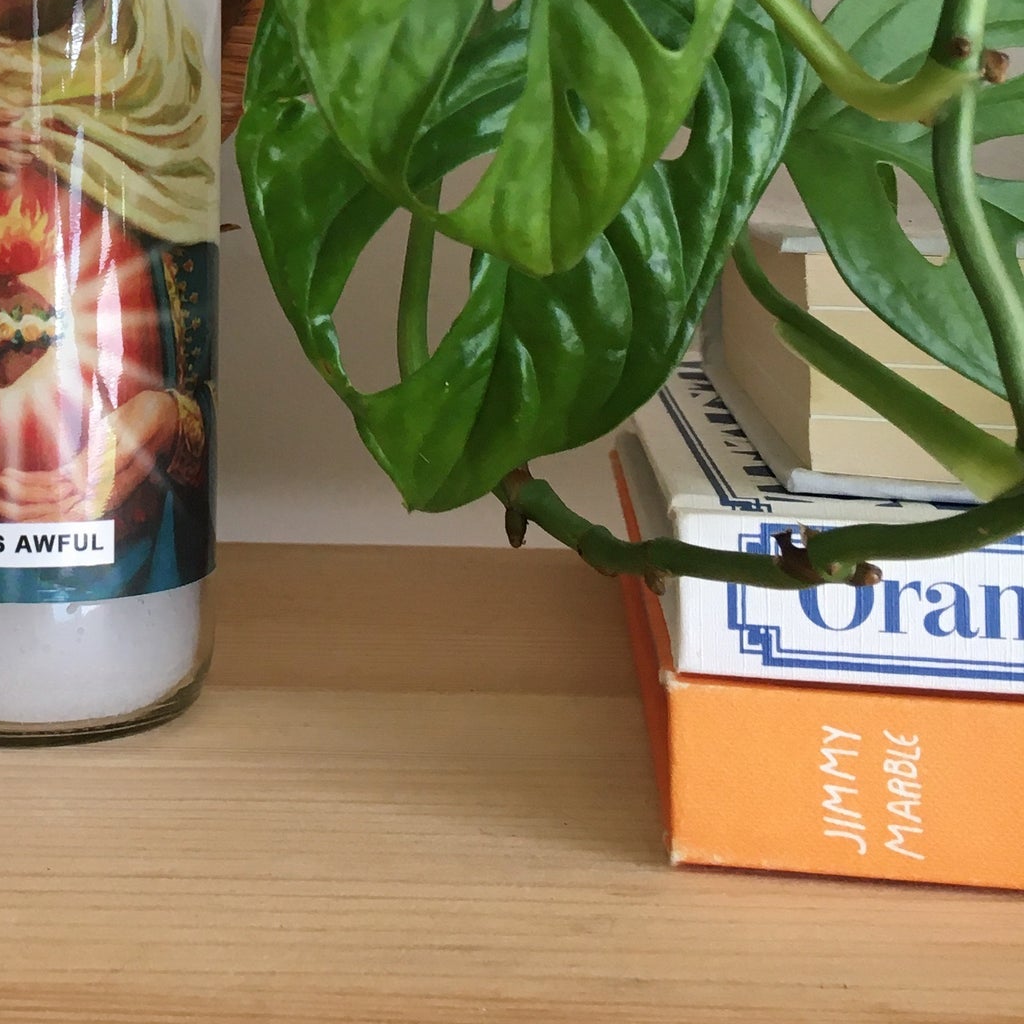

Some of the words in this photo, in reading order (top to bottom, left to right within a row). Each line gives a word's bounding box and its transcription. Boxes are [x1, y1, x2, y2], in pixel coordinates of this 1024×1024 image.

[14, 533, 104, 553] AWFUL
[819, 725, 867, 855] JIMMY
[882, 729, 925, 860] MARBLE
